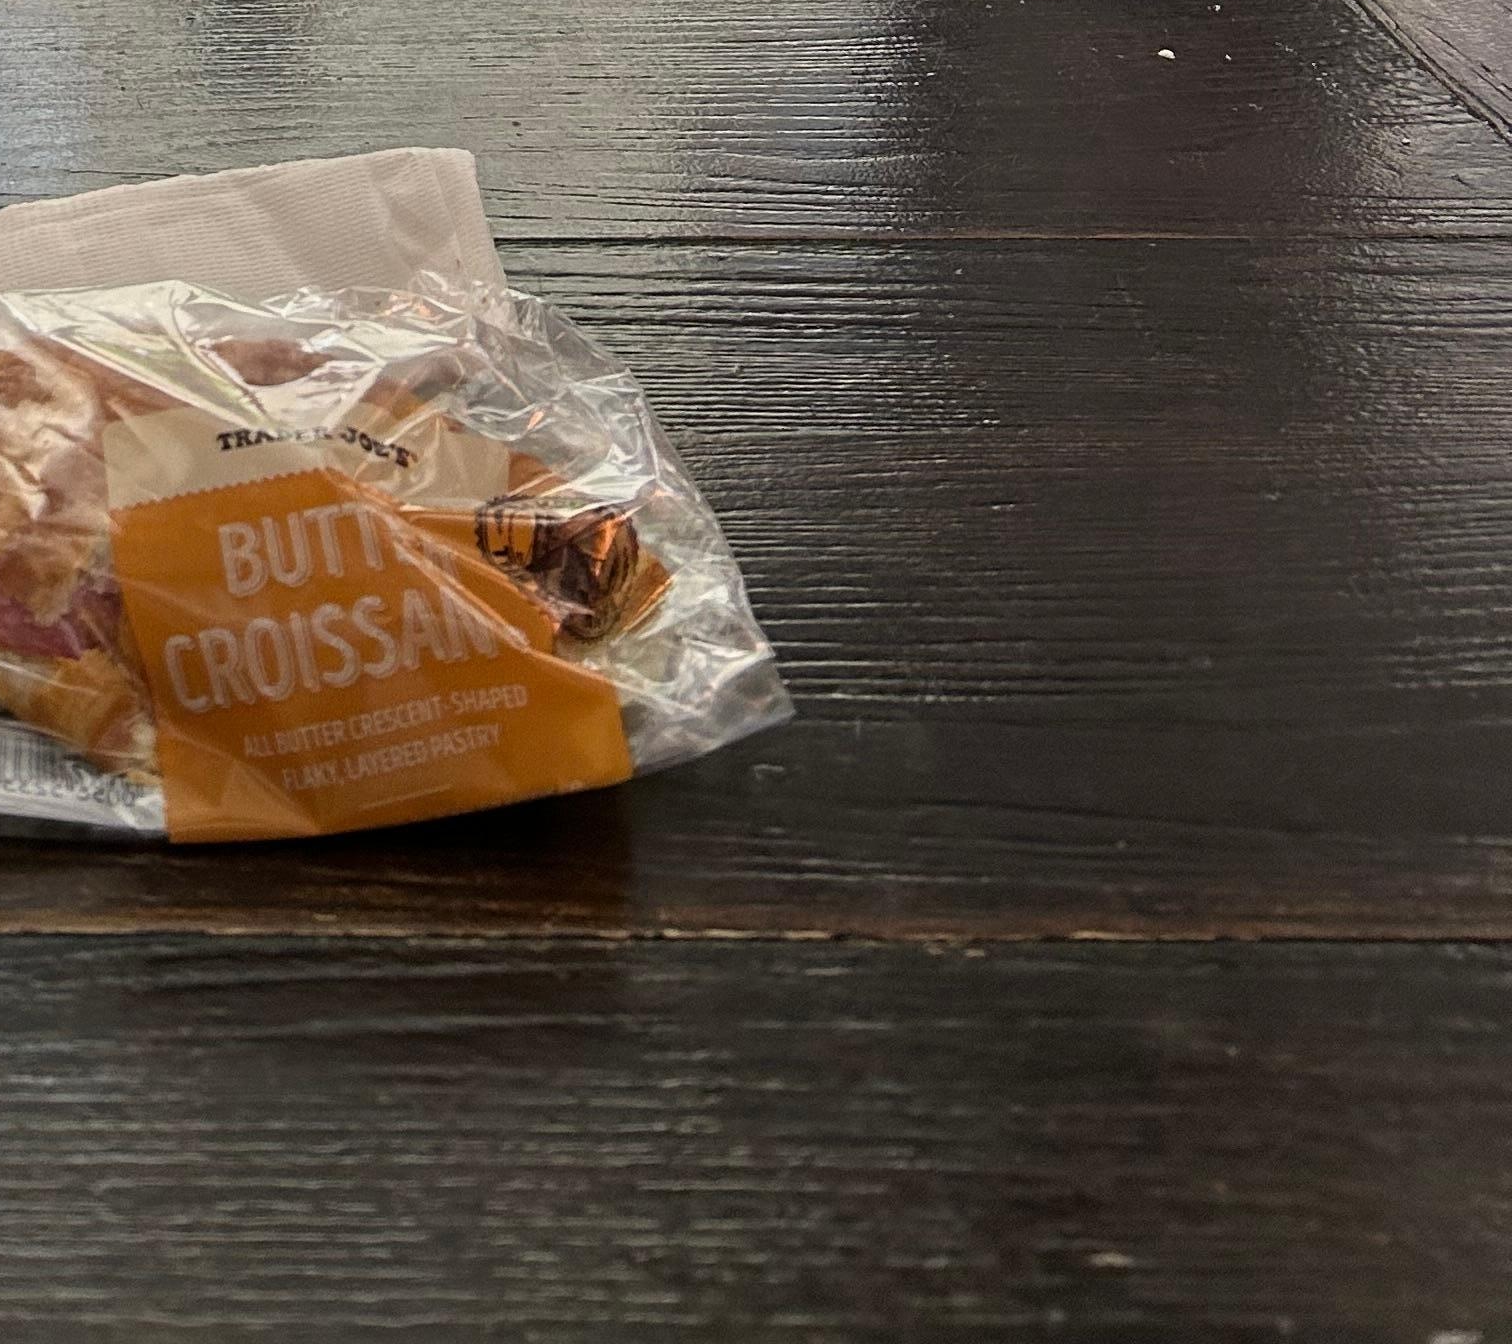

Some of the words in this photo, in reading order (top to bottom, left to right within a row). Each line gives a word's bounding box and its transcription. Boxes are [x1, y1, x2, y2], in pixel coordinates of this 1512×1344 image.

[275, 718, 345, 753] BUTTER
[346, 740, 428, 781] LAYERED
[430, 723, 500, 756] PASTRY
